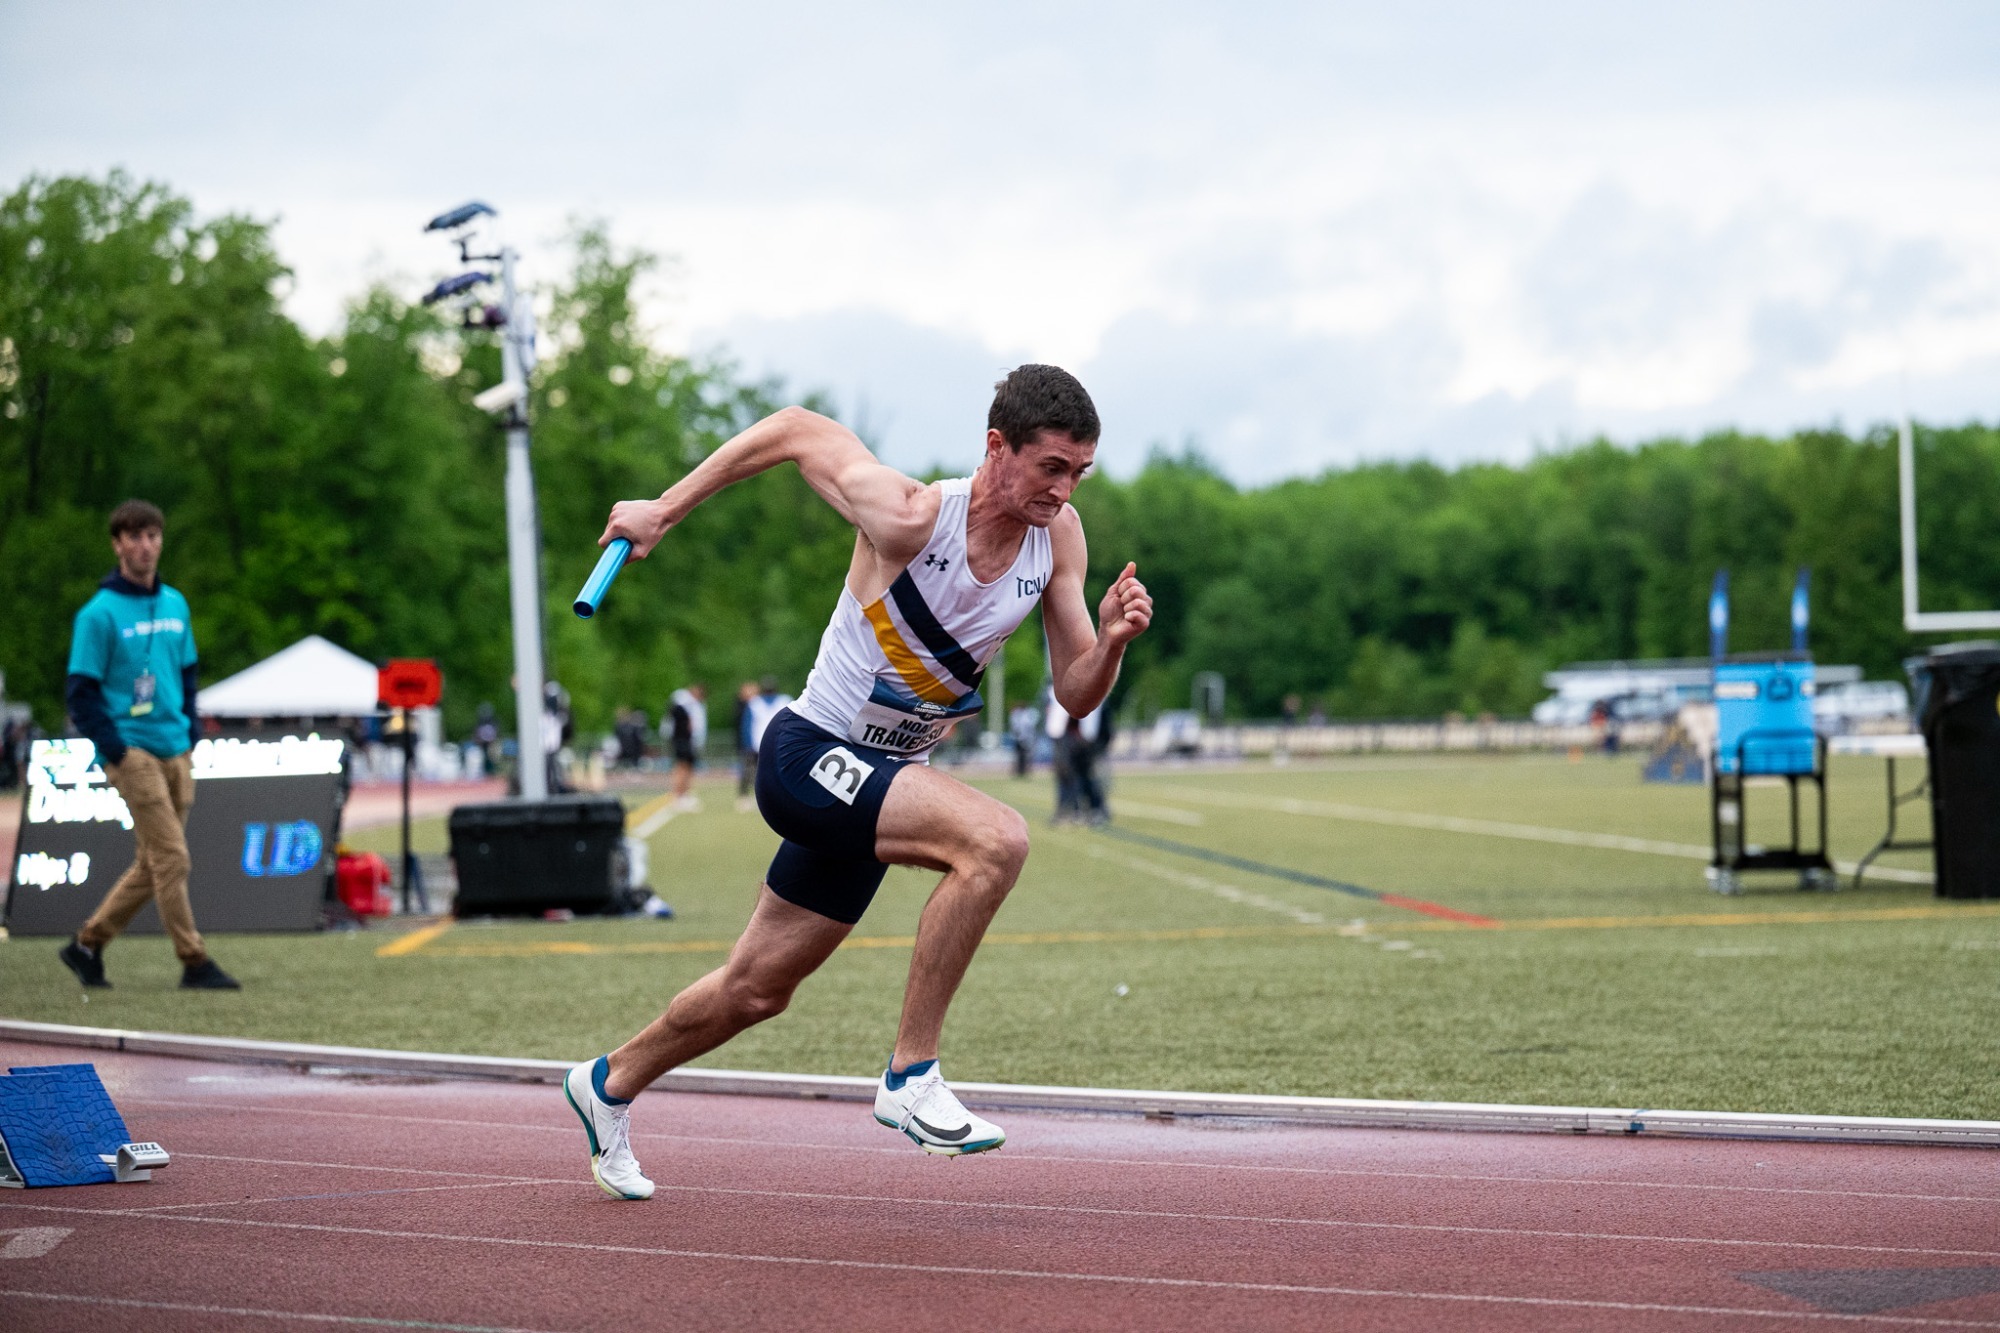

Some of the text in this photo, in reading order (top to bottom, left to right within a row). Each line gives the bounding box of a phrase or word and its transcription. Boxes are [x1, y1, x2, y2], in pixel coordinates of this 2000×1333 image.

[1016, 571, 1047, 598] TCNJ
[818, 754, 862, 795] 3
[130, 1143, 158, 1152] GILL
